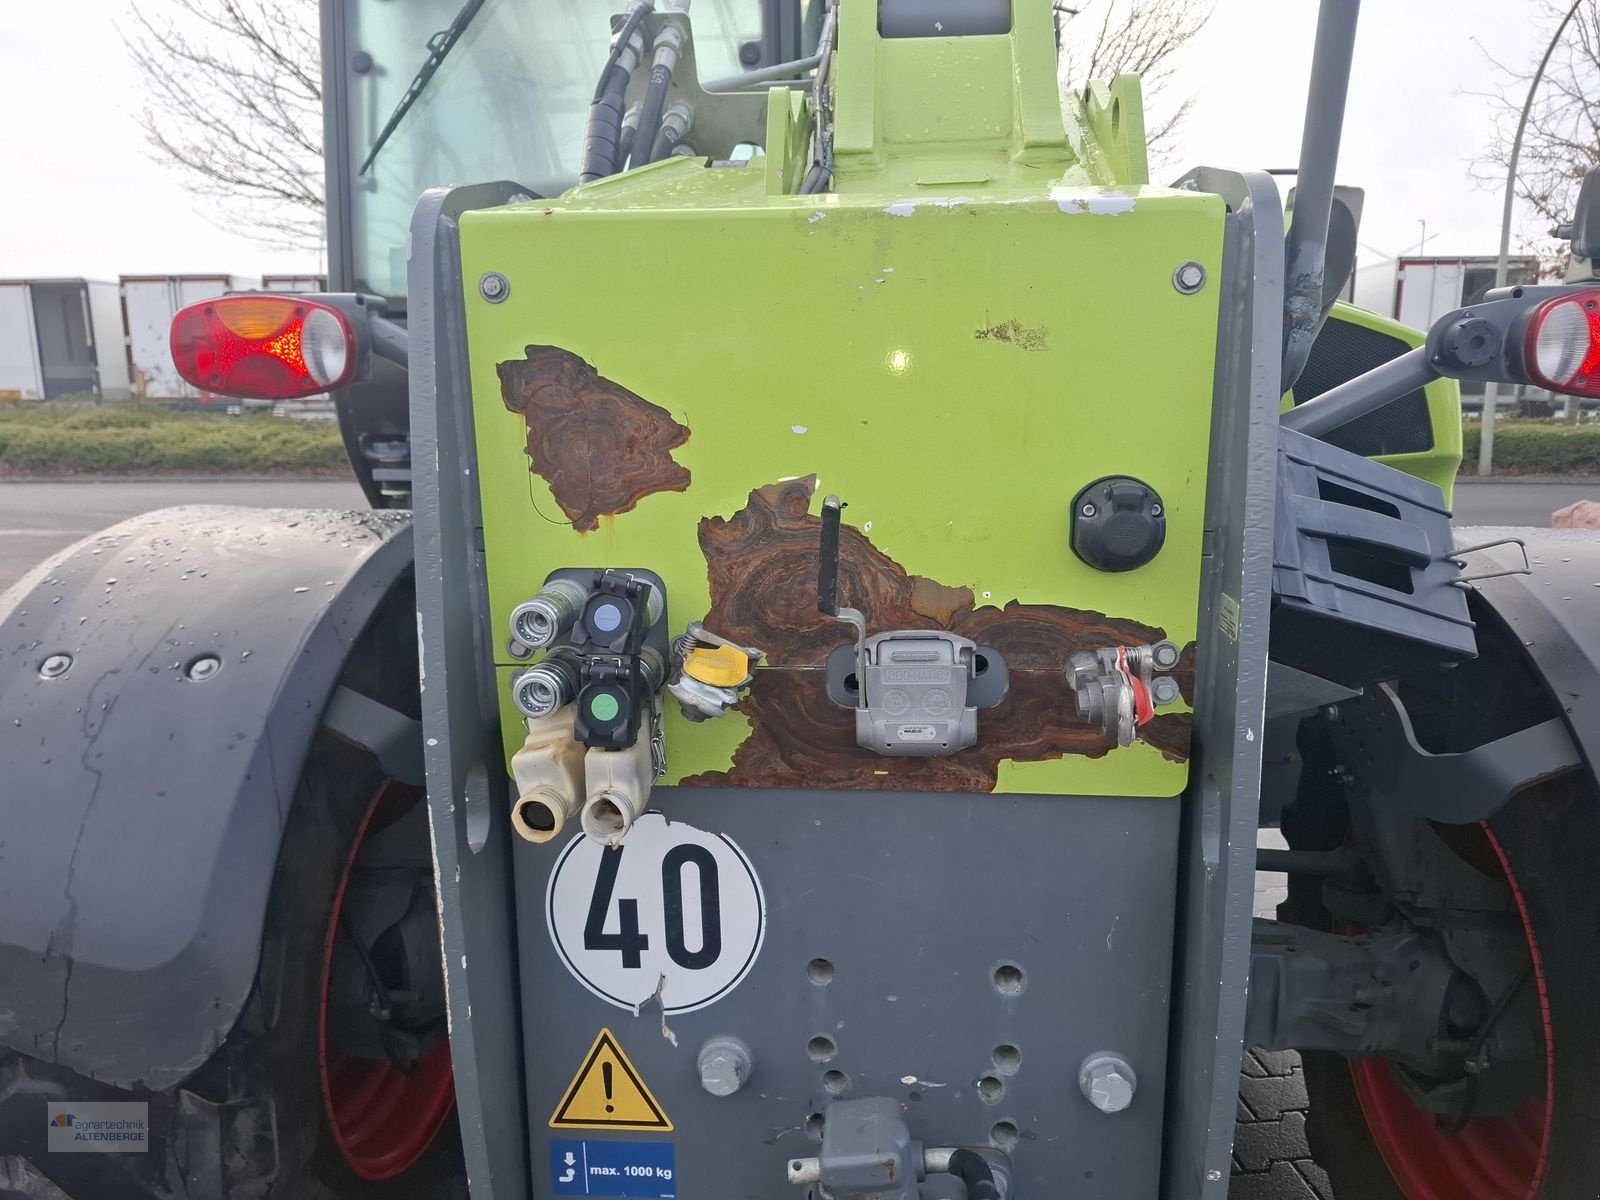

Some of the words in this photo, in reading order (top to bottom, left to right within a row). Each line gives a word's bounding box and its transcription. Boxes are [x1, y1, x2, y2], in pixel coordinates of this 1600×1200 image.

[584, 843, 722, 970] 40
[590, 1166, 620, 1176] max.
[624, 1165, 653, 1177] 1000
[656, 1167, 672, 1180] kg
